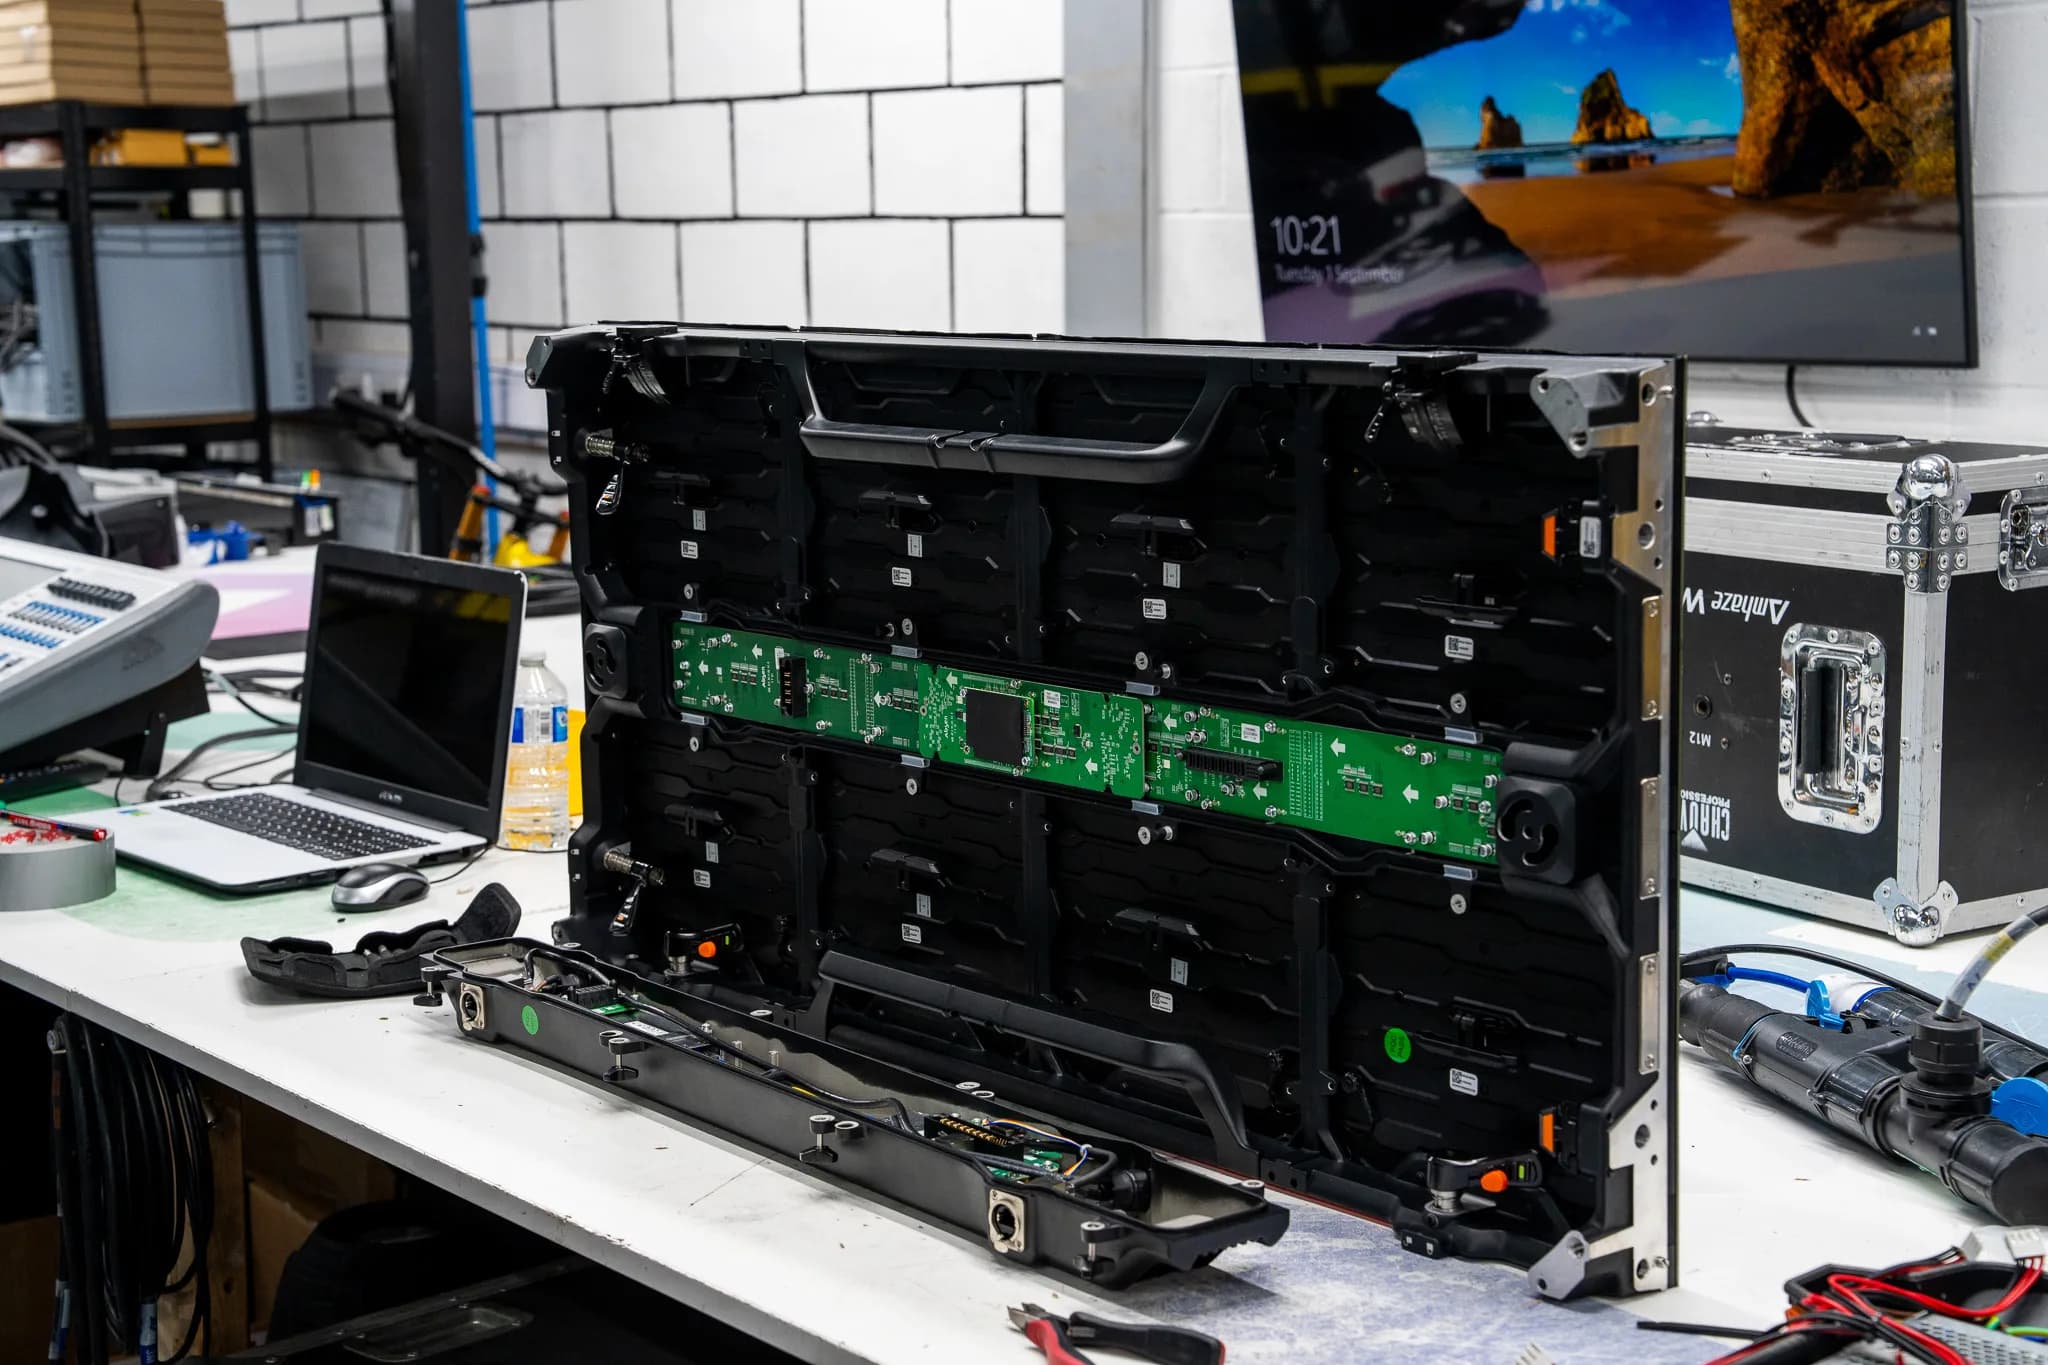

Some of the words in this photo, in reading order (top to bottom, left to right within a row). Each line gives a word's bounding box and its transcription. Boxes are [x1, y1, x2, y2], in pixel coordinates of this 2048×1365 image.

[1270, 215, 1342, 256] 10:21
[1274, 264, 1323, 286] Tuesday
[1335, 264, 1405, 285] September
[1682, 587, 1705, 615] W
[1711, 590, 1790, 625] Amhaze
[1689, 730, 1712, 747] M12
[1680, 789, 1731, 809] PROFESSIO
[1680, 799, 1730, 841] CHAUV
